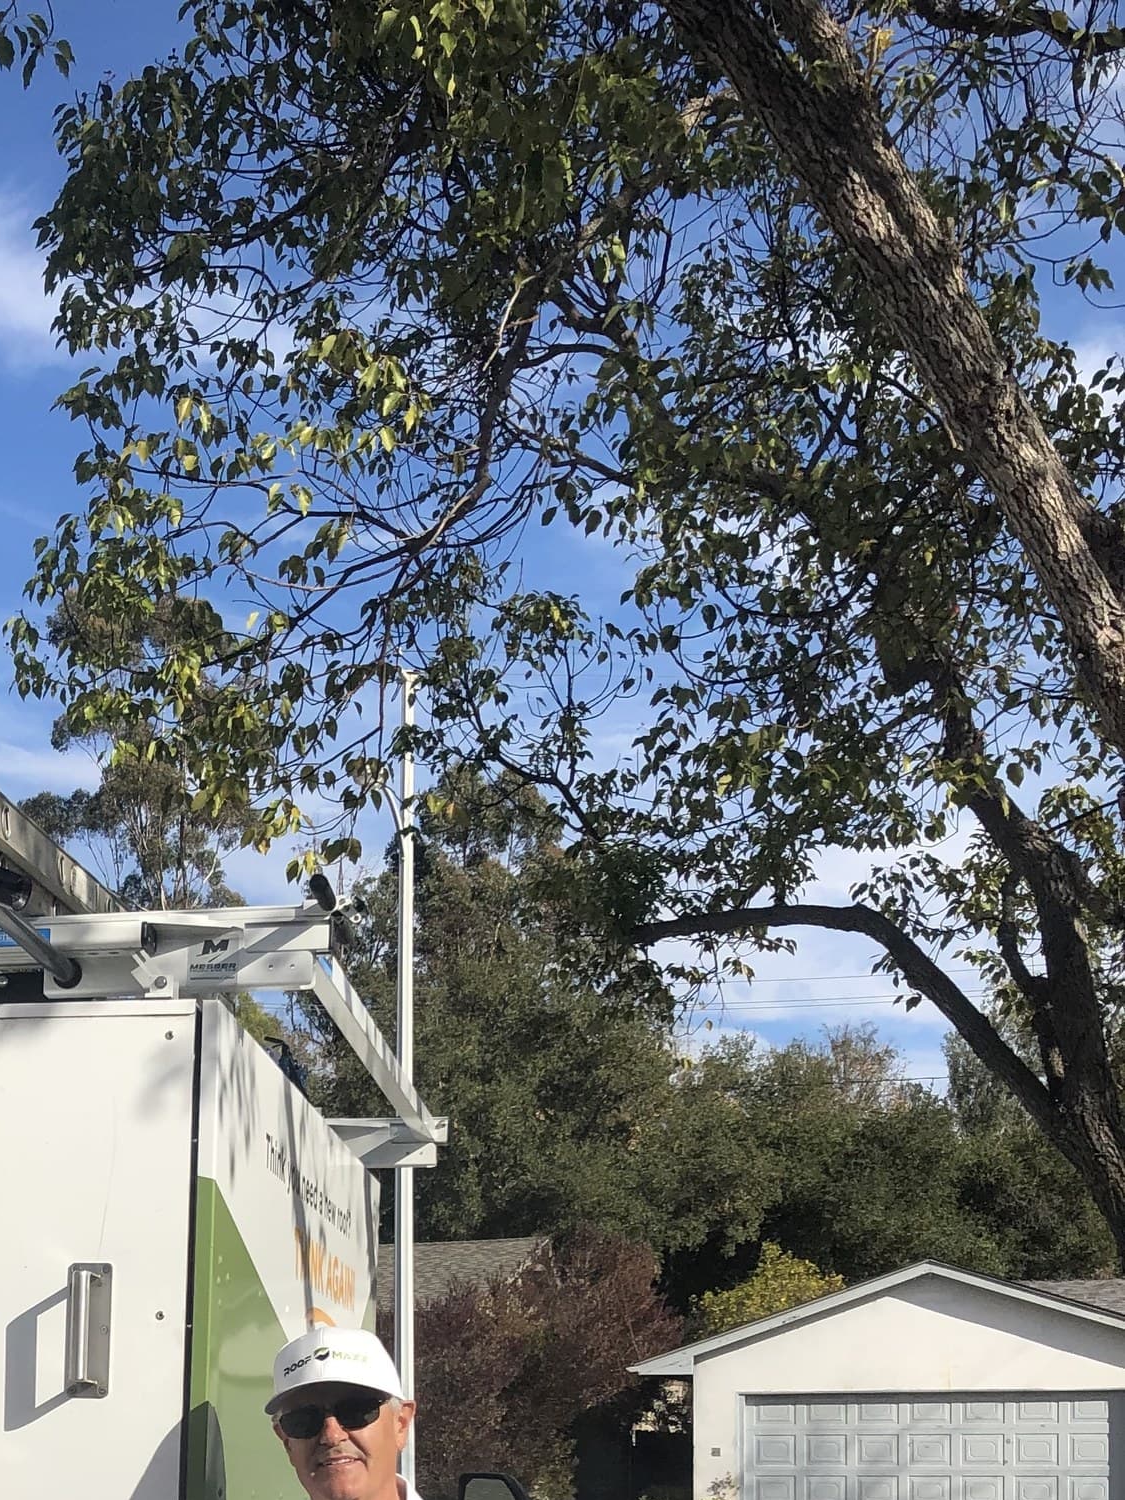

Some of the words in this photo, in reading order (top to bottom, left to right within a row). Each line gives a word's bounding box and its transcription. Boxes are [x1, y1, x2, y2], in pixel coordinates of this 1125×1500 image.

[265, 1132, 286, 1184] Think
[301, 1173, 318, 1211] need
[324, 1196, 337, 1227] new
[283, 1354, 312, 1377] ROOF
